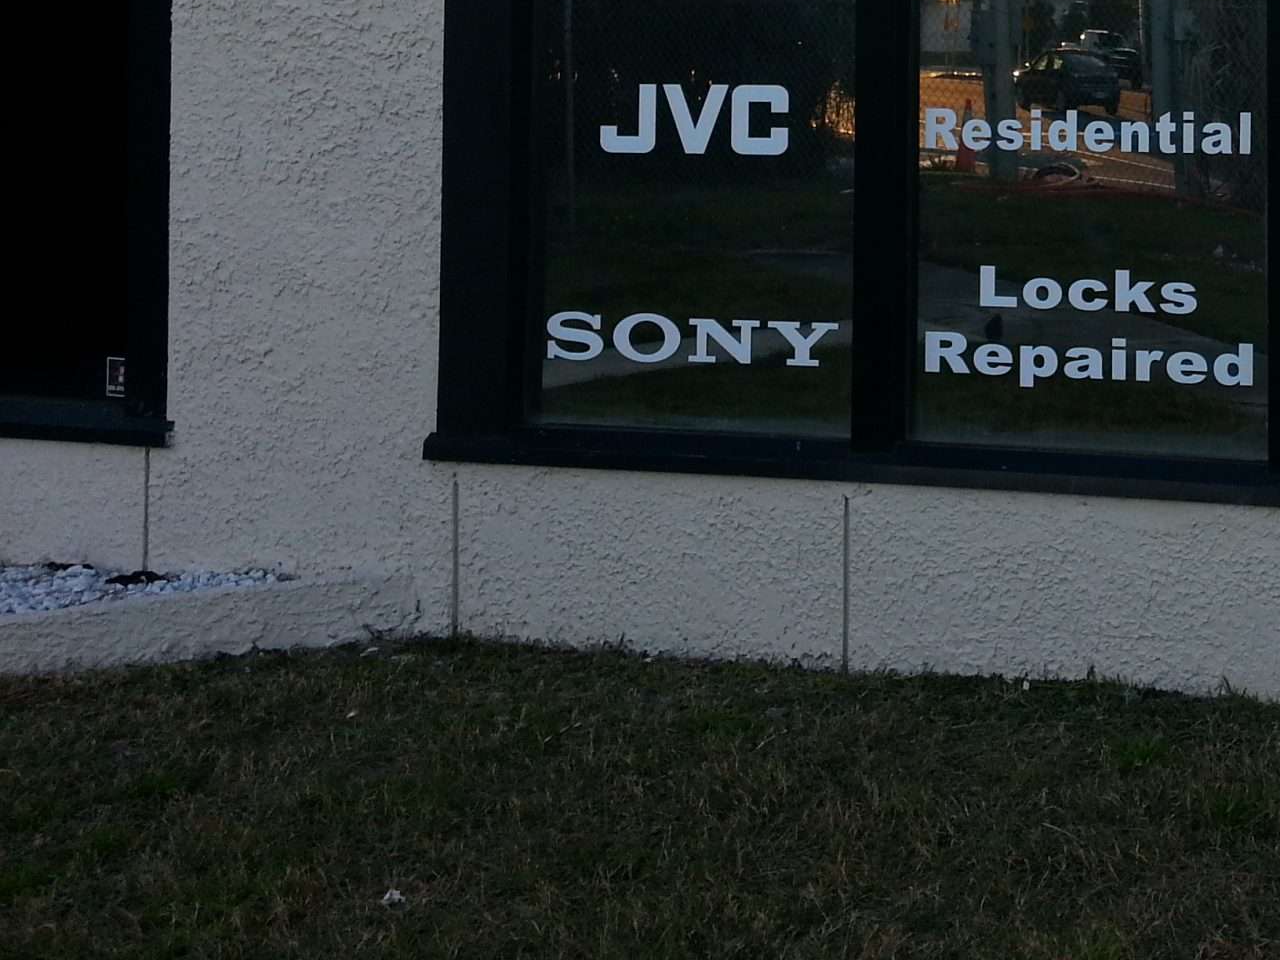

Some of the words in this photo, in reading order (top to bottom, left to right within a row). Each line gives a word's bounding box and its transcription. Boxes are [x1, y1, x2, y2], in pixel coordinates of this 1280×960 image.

[600, 83, 789, 155] JVC
[924, 107, 1253, 155] Residential
[979, 265, 1198, 314] Locks
[546, 311, 839, 367] SONY
[924, 331, 1254, 388] Repaired
